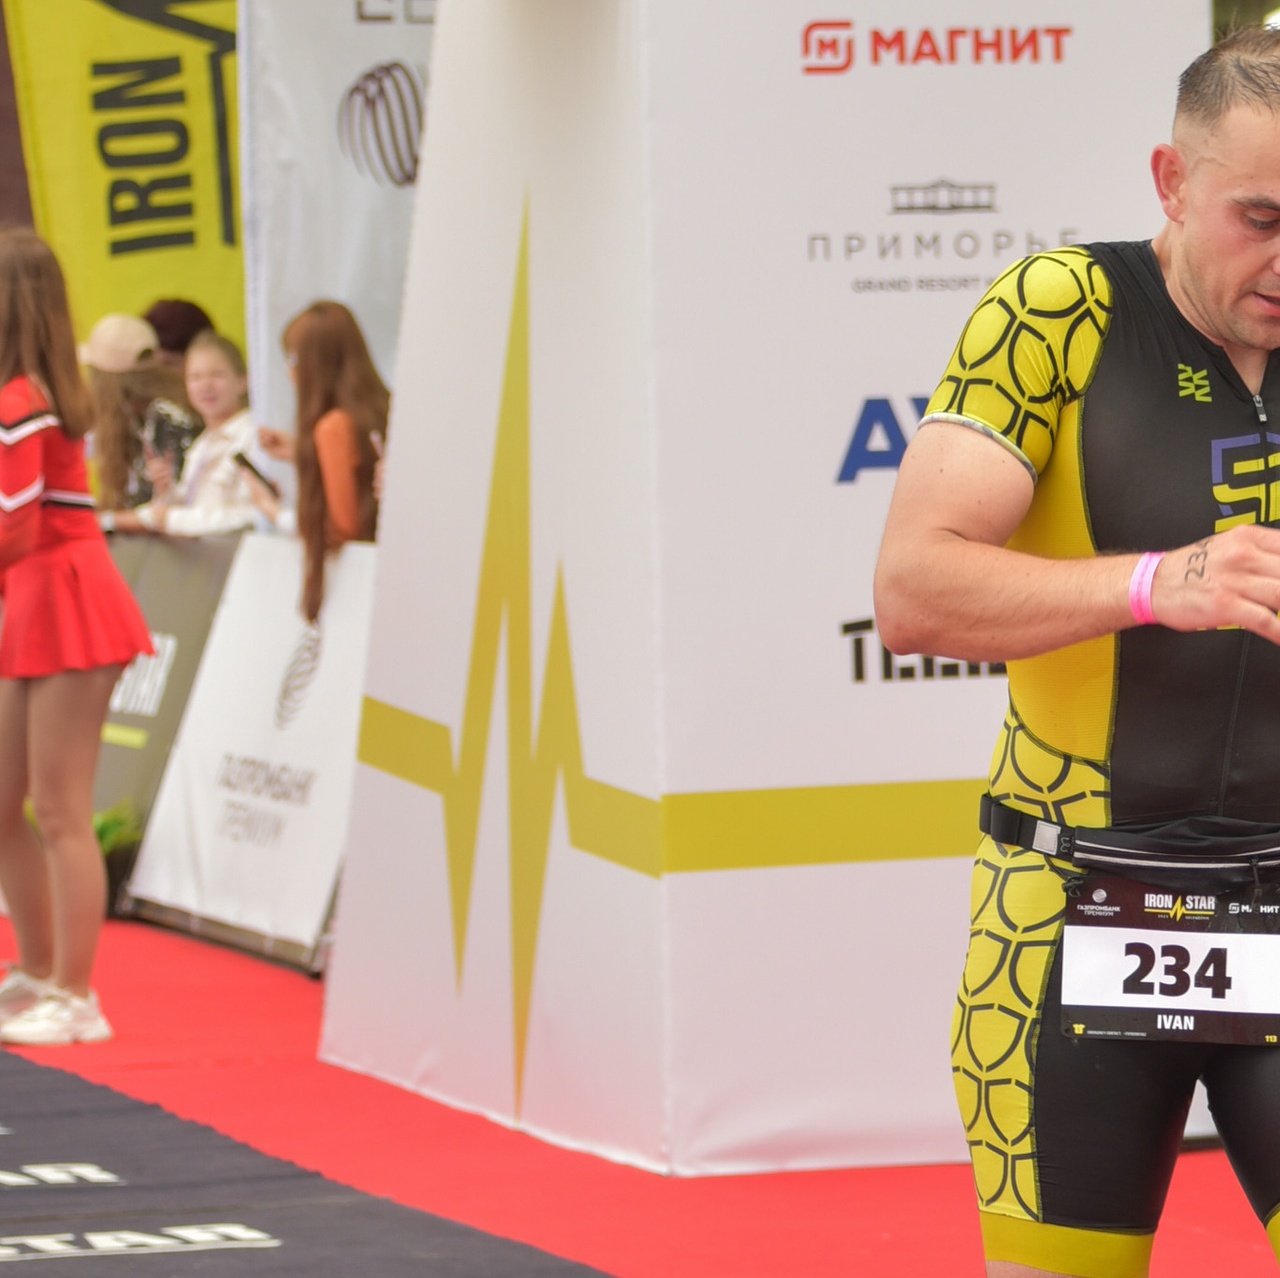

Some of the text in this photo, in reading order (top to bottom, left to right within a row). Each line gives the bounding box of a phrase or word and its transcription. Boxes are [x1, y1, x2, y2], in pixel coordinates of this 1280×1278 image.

[869, 27, 1073, 65] МАГНИТ
[91, 56, 196, 256] IRON
[851, 277, 912, 293] GRAND
[1144, 893, 1216, 910] IRON STAR
[1241, 904, 1280, 914] МНИТ
[1122, 941, 1232, 1000] 234
[1156, 1013, 1195, 1031] IVAN
[0, 1223, 272, 1252] TAR
